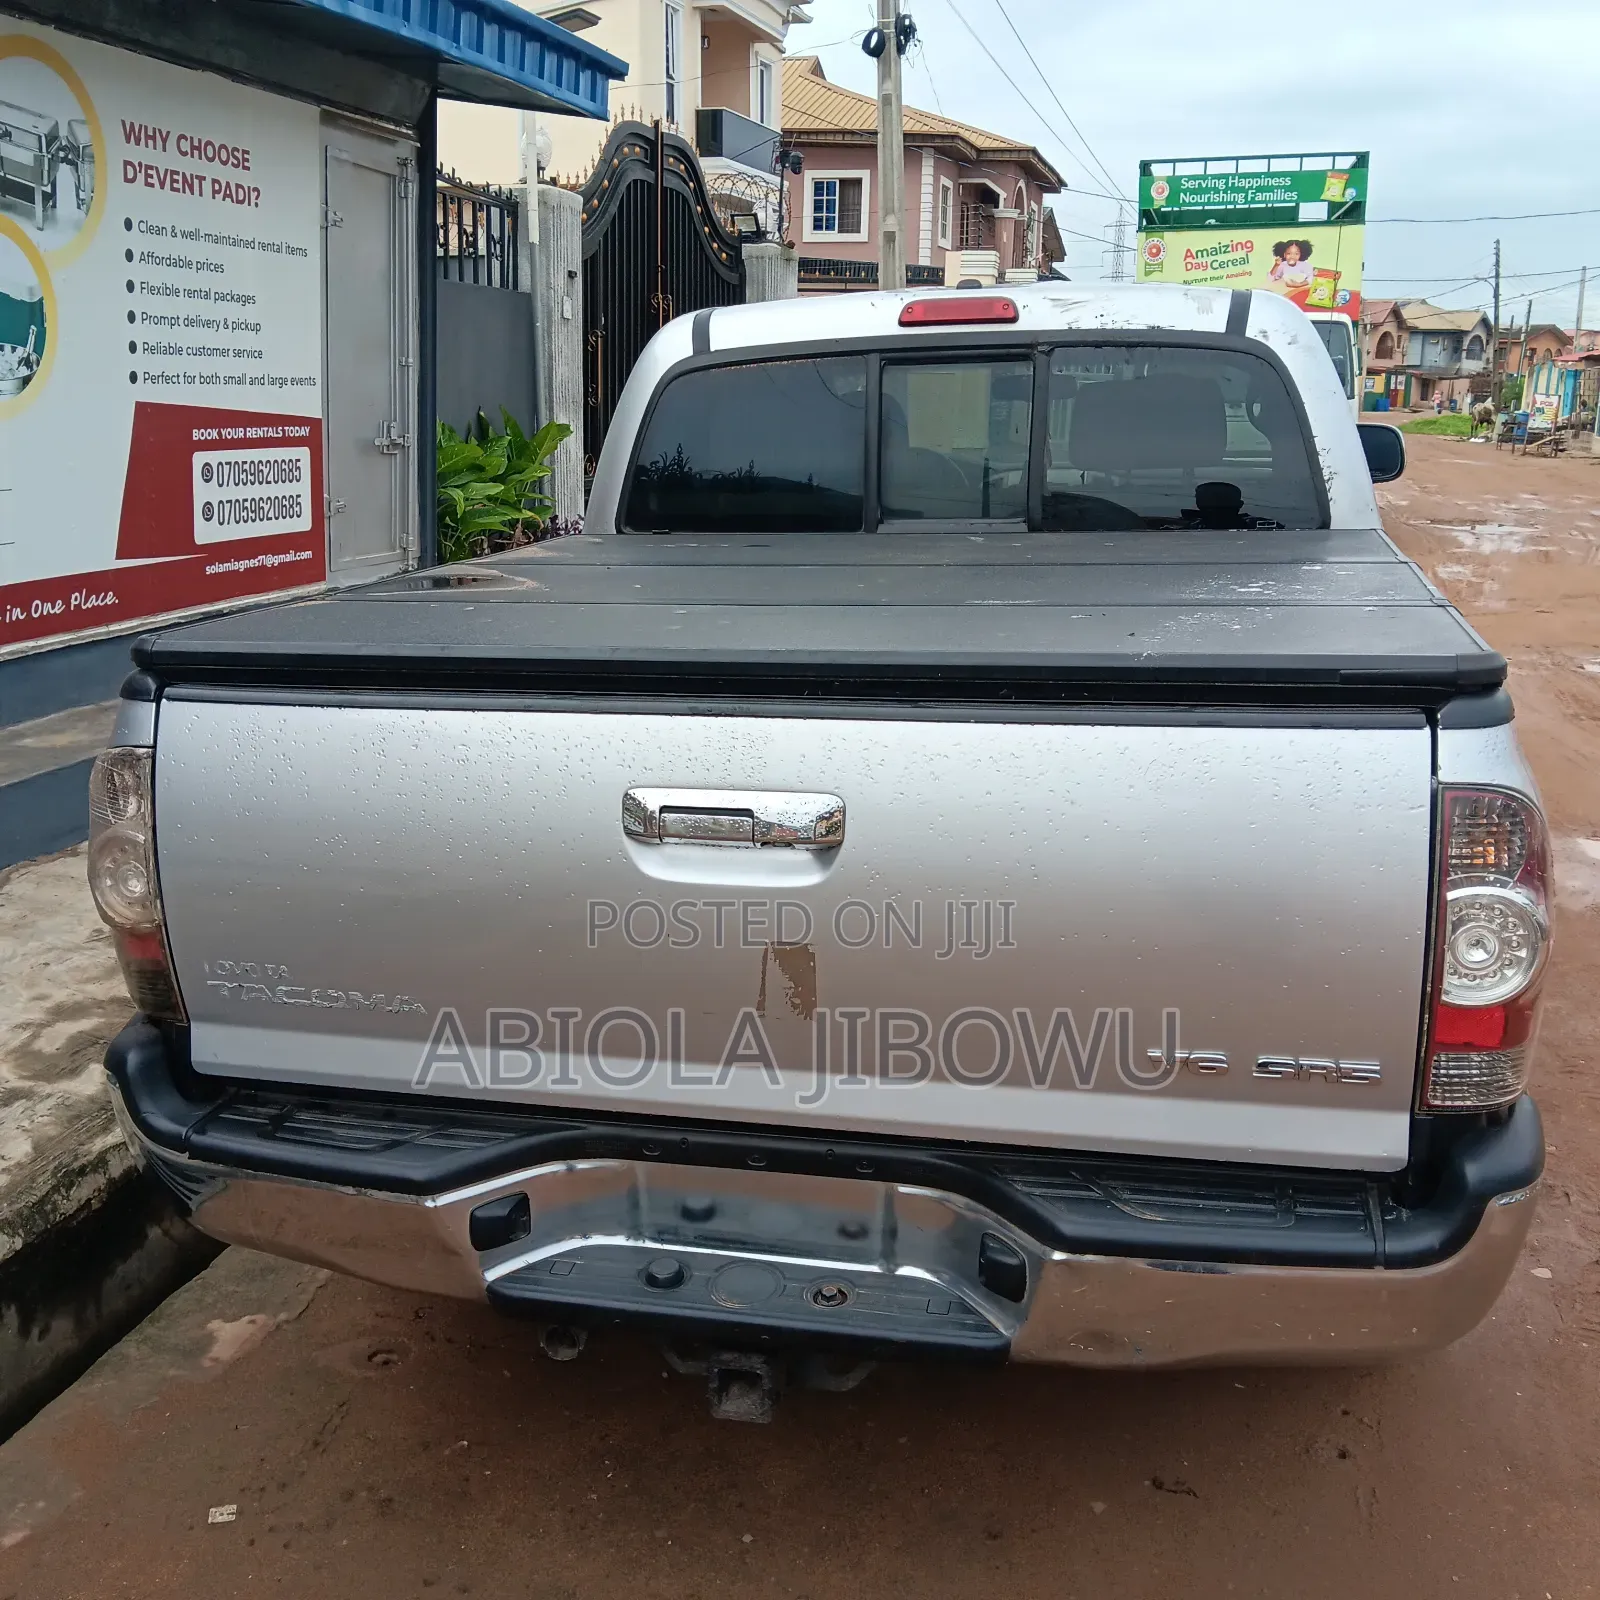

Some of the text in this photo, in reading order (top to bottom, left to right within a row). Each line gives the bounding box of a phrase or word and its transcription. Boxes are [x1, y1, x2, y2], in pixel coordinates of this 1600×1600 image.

[121, 119, 251, 171] WHY CHOOSE
[123, 159, 261, 208] D'EVENT PADI?
[1180, 177, 1226, 190] Serving
[1228, 174, 1292, 189] Happiness
[1179, 189, 1299, 204] Nourishing Families
[137, 219, 308, 258] Clean & well-maintained rental items
[1183, 239, 1254, 262] Amaizing
[1184, 252, 1250, 272] Day Cereal
[139, 251, 225, 274] Affordable prices
[1182, 270, 1252, 285] Nurture their Amaizing
[140, 281, 257, 307] Flexible rental packages
[141, 311, 262, 335] Prompt delivery & pickup
[142, 341, 263, 360] Reliable customer service
[143, 371, 317, 389] Perfect for both small and large events
[192, 426, 311, 441] BOOK YOUR RENTALS TODAY
[216, 458, 302, 488] 07059620685
[217, 494, 303, 526] 07059620685
[205, 550, 313, 575] solamiagnes71@gmail.com
[5, 588, 119, 624] in One Place.
